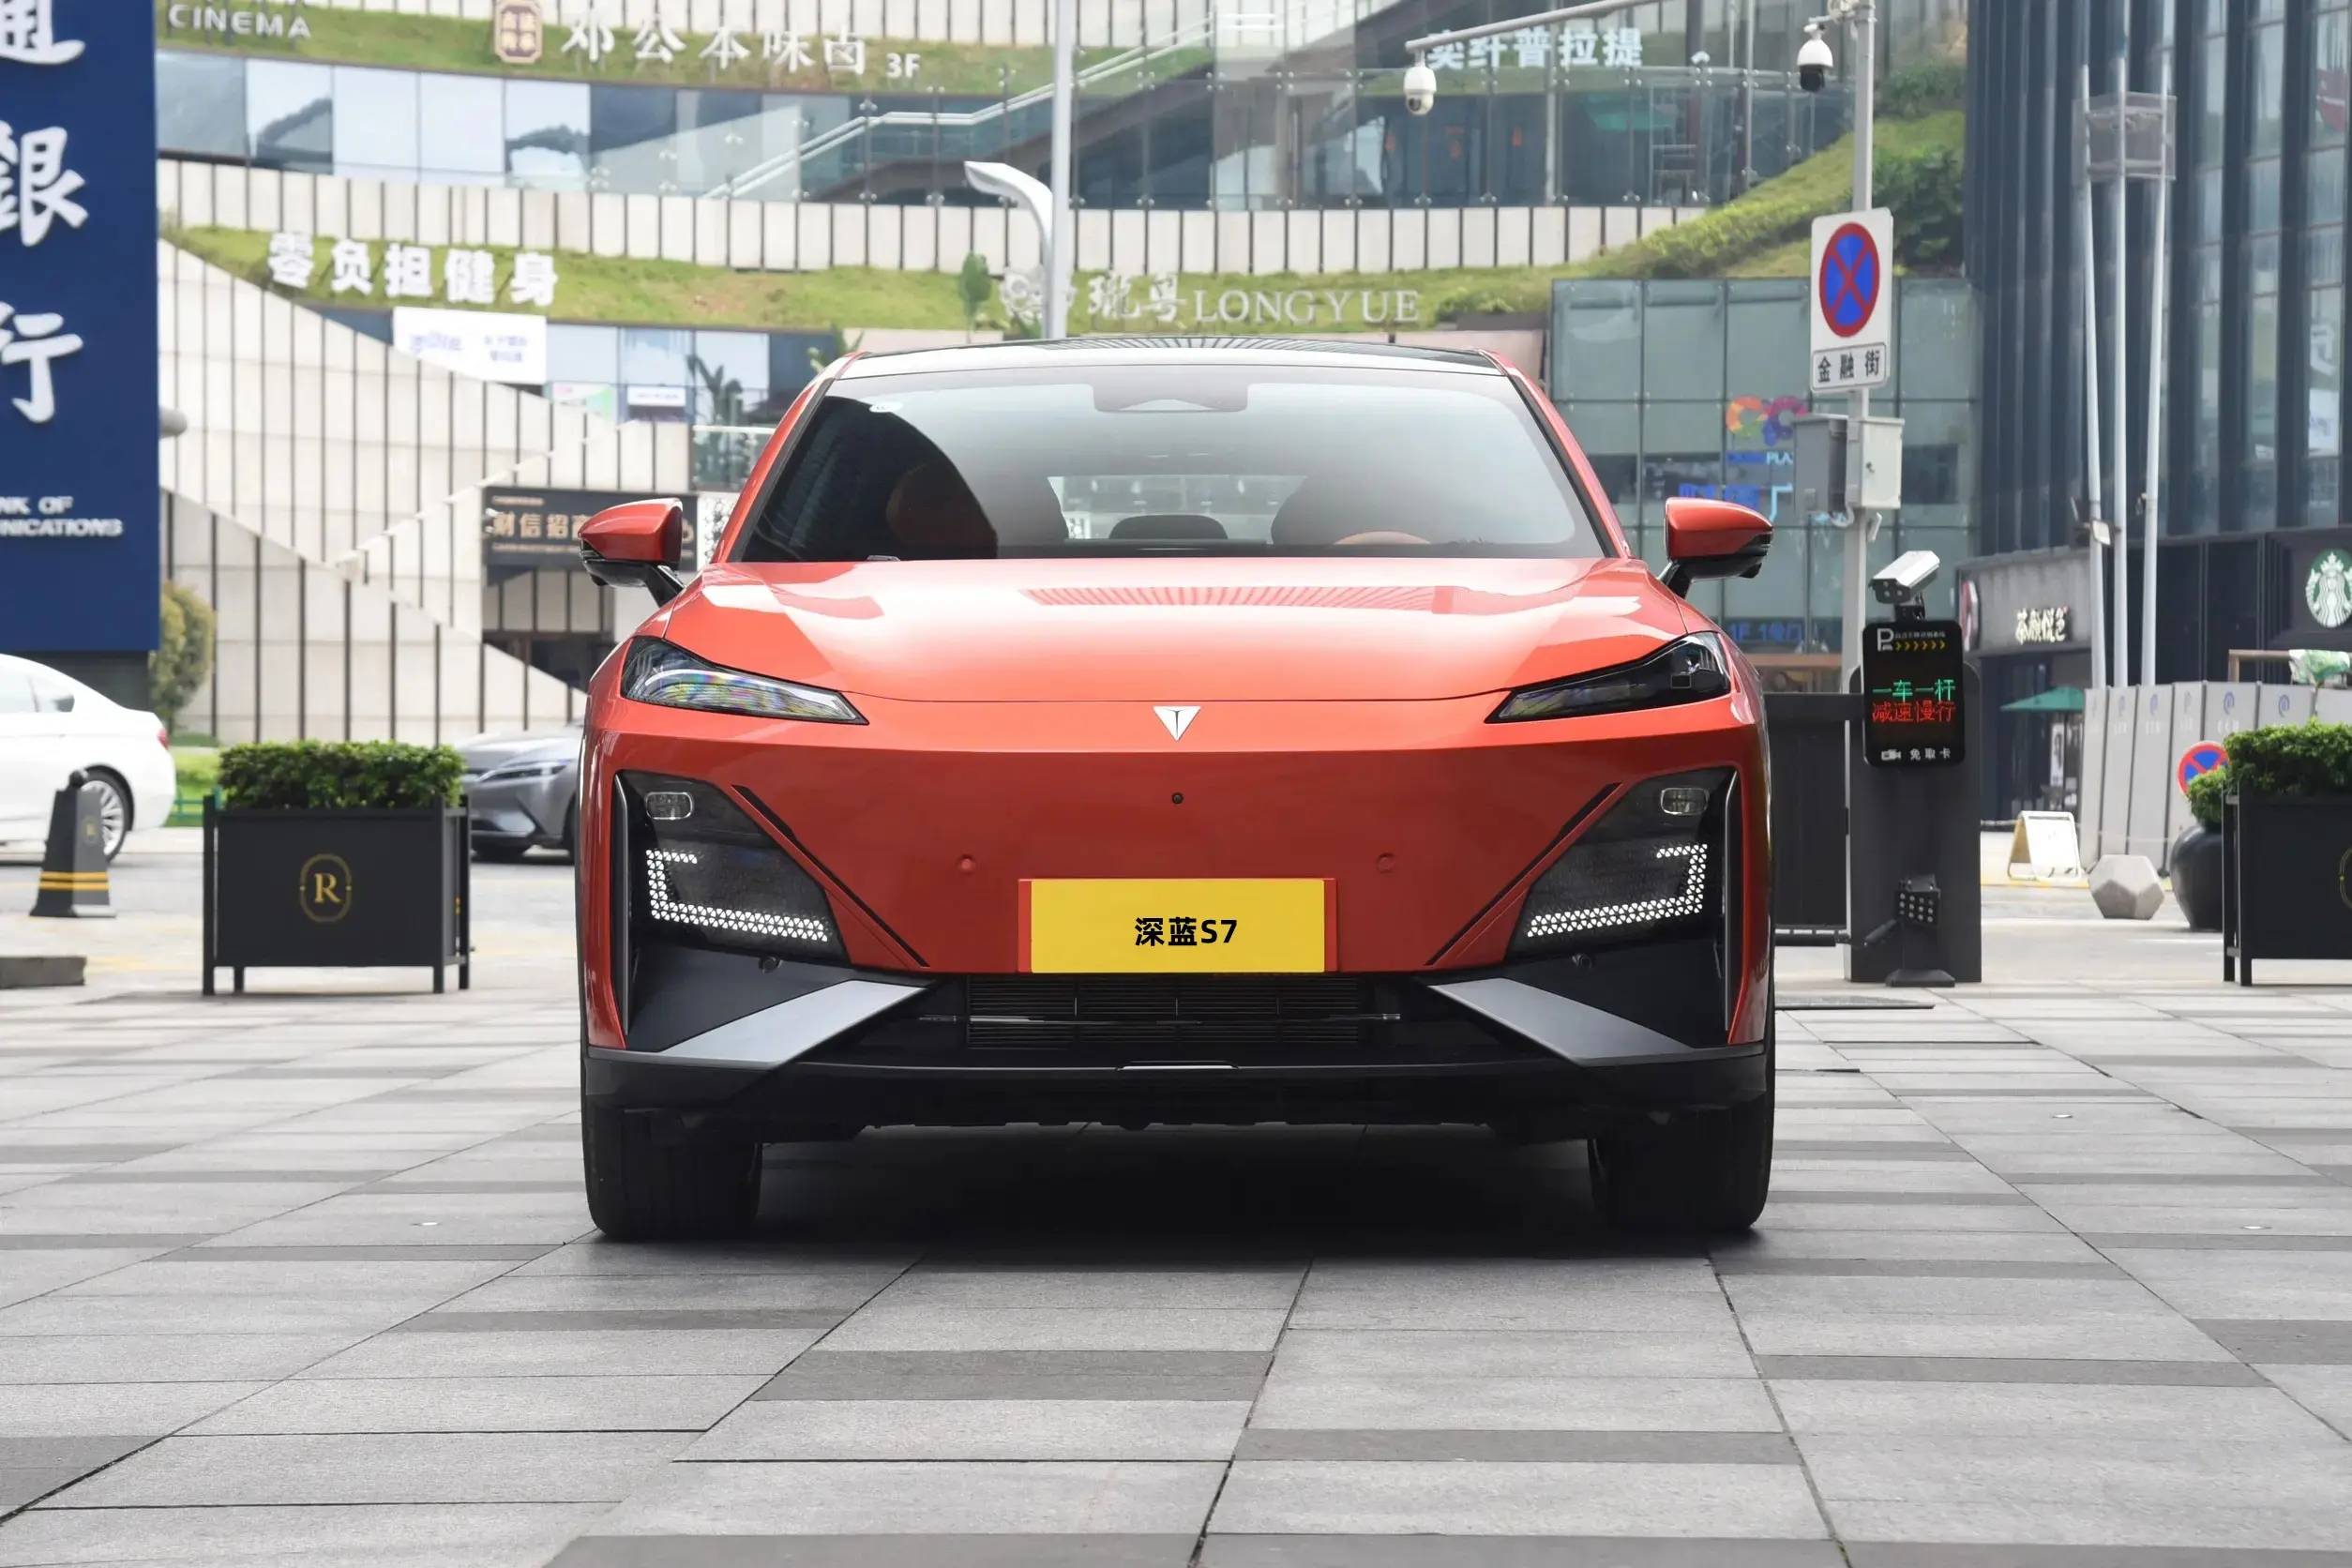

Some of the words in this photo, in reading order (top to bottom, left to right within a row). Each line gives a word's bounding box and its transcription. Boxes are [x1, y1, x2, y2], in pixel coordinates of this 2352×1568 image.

[168, 4, 311, 38] CINEMA
[561, 15, 865, 75] 邓公本味卤
[885, 53, 921, 78] 3F
[267, 232, 558, 306] 零负担健身
[1817, 349, 1880, 383] 金融街
[1766, 451, 1793, 464] PLA
[38, 495, 74, 515] OF
[1873, 678, 1956, 702] 一车一杆
[1873, 701, 1956, 722] 减速慢行
[1909, 747, 1952, 761] 免取卡
[314, 873, 341, 903] R
[1135, 916, 1238, 946] 深蓝S7
